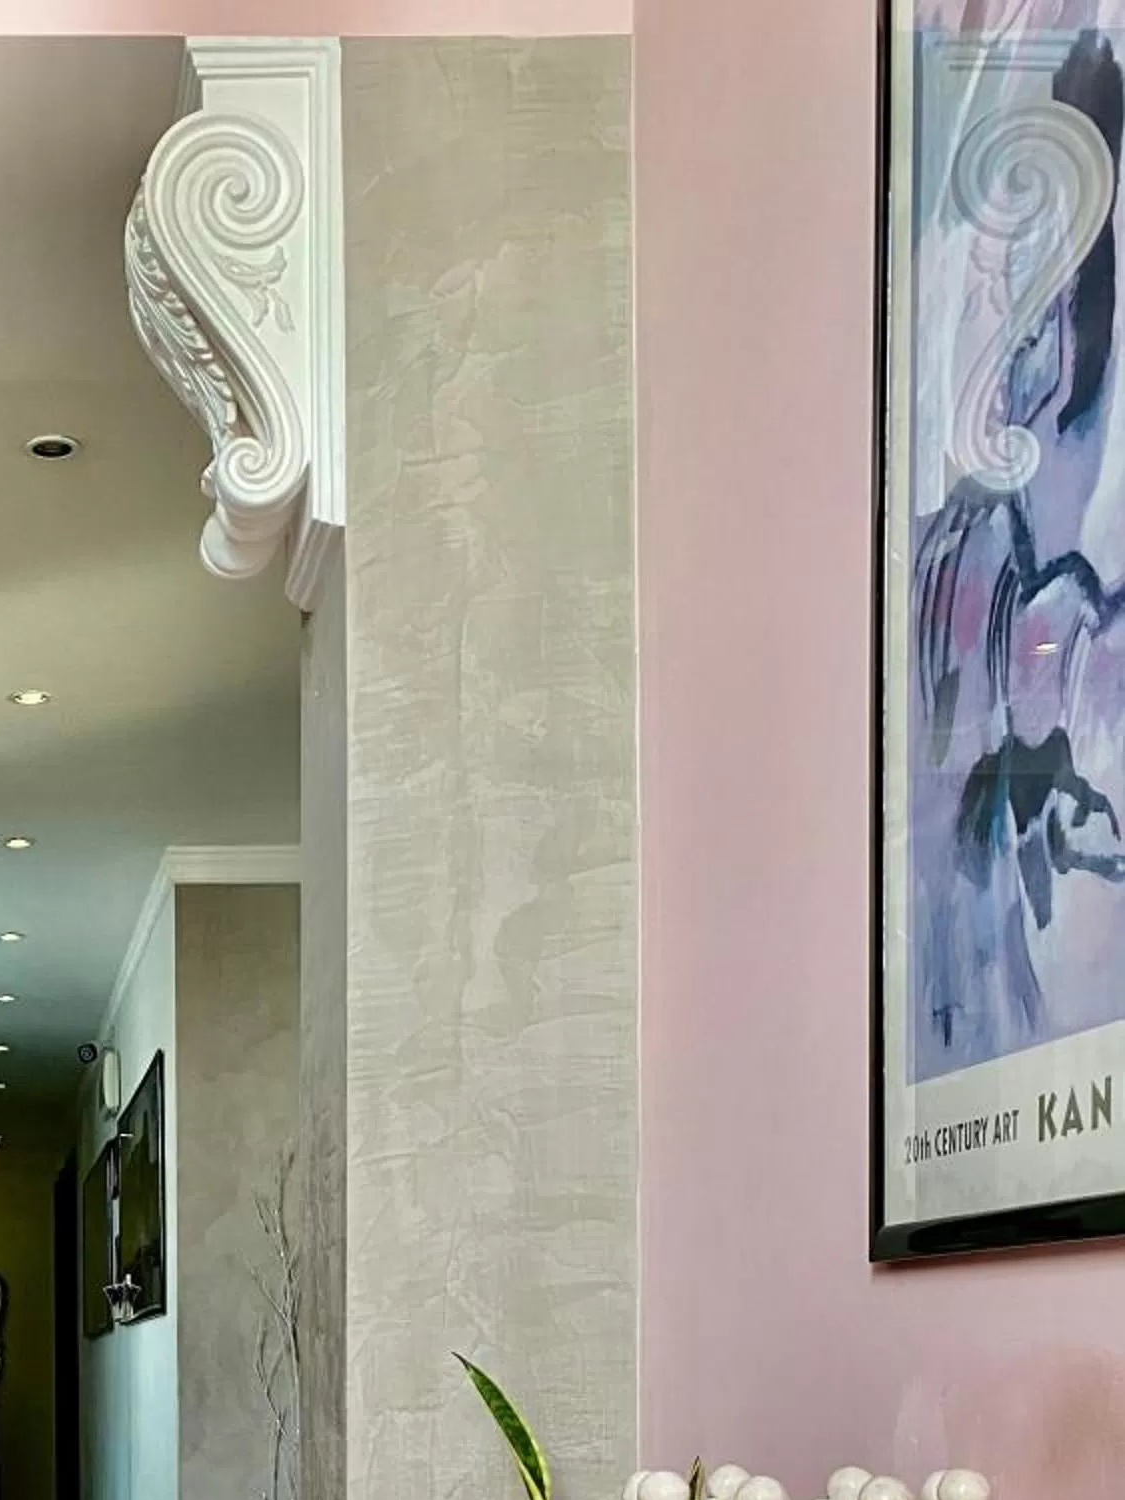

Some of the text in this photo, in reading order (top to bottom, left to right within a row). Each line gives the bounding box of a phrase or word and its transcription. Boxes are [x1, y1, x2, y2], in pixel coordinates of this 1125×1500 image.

[905, 1075, 1113, 1165] 20th CENTURY ART KAN
